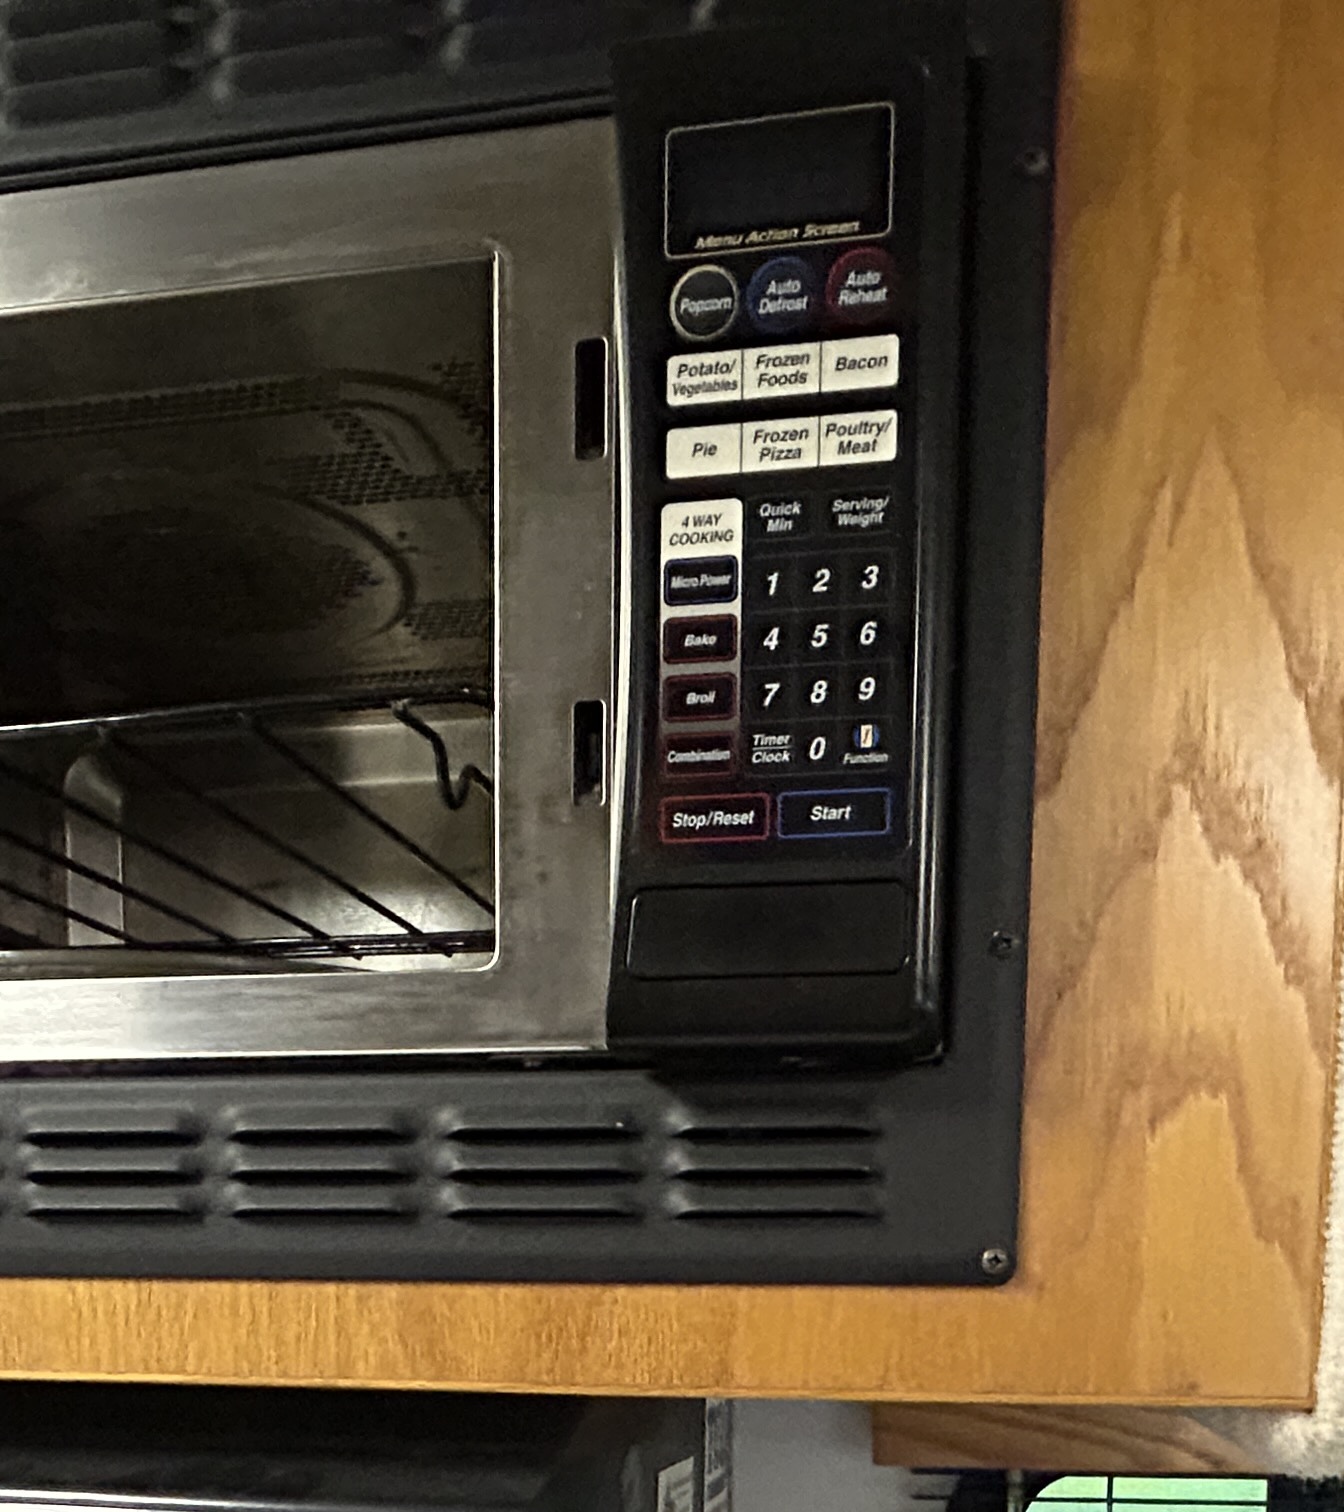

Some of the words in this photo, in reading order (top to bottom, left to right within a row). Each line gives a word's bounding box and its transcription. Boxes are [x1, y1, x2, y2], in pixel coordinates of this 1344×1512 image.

[694, 234, 742, 250] Menu
[745, 226, 799, 245] Action
[803, 220, 860, 239] Screen
[765, 279, 802, 295] Auto
[844, 271, 882, 287] Auto
[758, 296, 808, 315] Defrost
[837, 286, 888, 306] Reheat
[679, 296, 733, 316] Popcorn
[676, 358, 736, 379] Potato/
[755, 350, 811, 370] Frozen
[835, 353, 889, 373] Bacon
[671, 378, 738, 398] Vegetables
[757, 370, 808, 389] Foods
[752, 427, 810, 445] Frozen
[824, 415, 893, 439] Poultry/
[691, 441, 718, 459] Pie
[758, 446, 803, 463] Pizza
[836, 439, 878, 457] Meat
[758, 501, 802, 520] Quick
[831, 496, 890, 514] Serving/
[681, 515, 691, 529] 4
[691, 513, 722, 528] WAY
[766, 517, 793, 533] Min
[837, 510, 885, 527] Weight
[668, 529, 735, 547] COOKING
[766, 572, 779, 596] 1
[812, 568, 831, 593] 2
[860, 565, 879, 590] 3
[683, 632, 718, 648] Bake
[763, 627, 779, 651] 4
[810, 624, 830, 648] 5
[859, 621, 877, 645] 6
[685, 691, 716, 706] Broil
[763, 683, 780, 707] 7
[810, 680, 828, 704] 8
[858, 677, 876, 701] 9
[752, 733, 791, 747] Timer
[809, 736, 827, 761] 0
[666, 748, 732, 764] Combination
[751, 750, 791, 765] Clock
[843, 752, 889, 765] Function
[672, 810, 755, 829] Stop/Reset
[810, 805, 852, 822] Start
